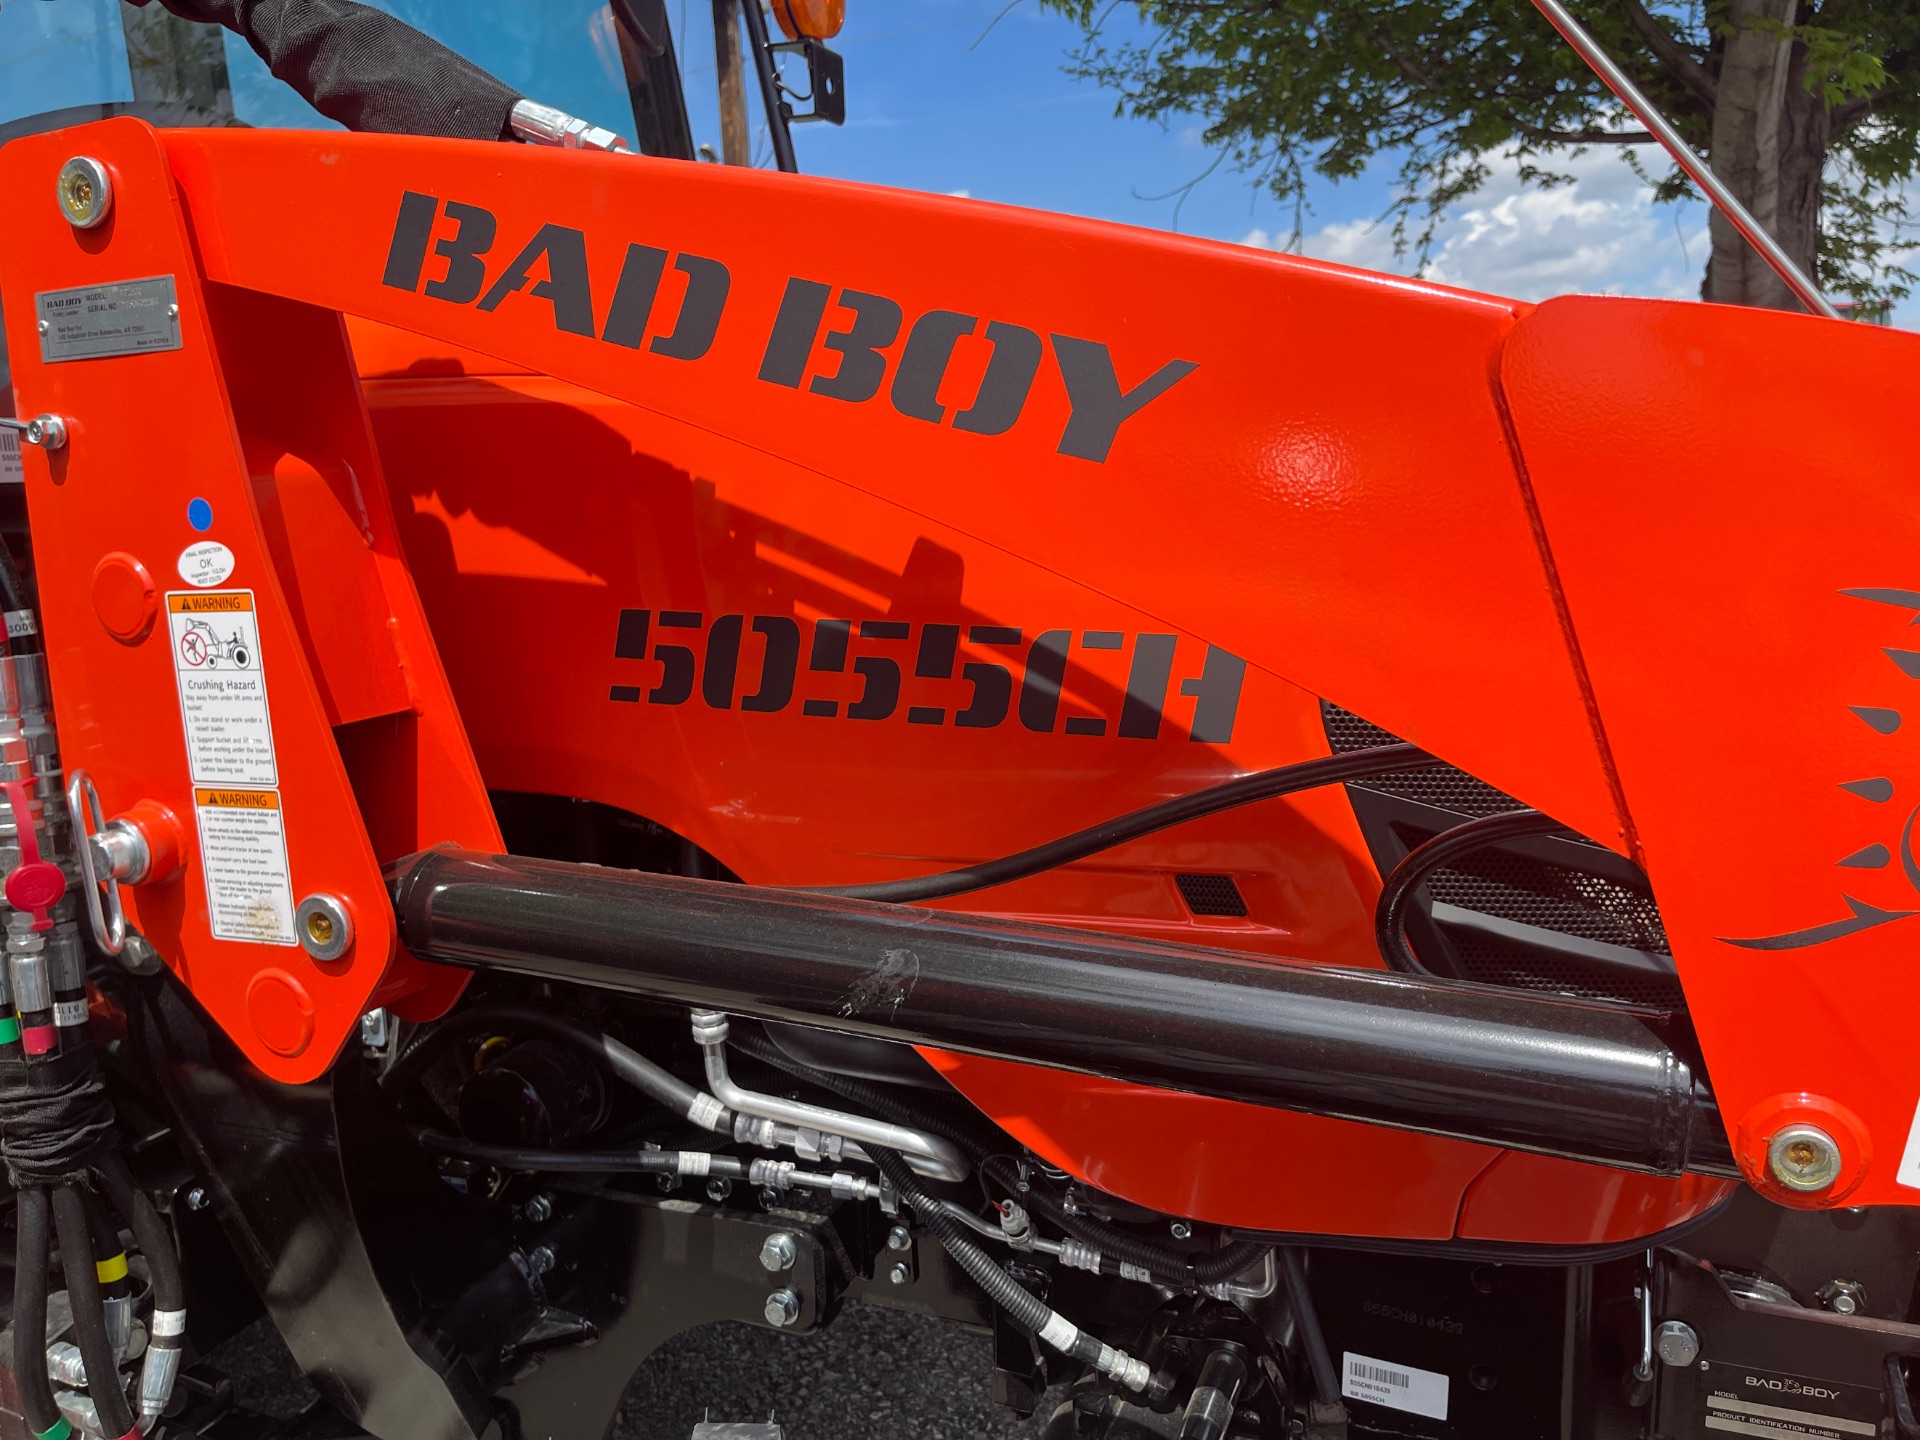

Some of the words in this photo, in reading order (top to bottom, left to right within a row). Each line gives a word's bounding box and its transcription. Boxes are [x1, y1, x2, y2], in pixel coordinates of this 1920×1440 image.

[47, 299, 64, 308] BAD
[66, 298, 82, 307] BOY
[88, 305, 107, 313] SERIAL
[382, 190, 731, 362] BAD
[757, 275, 1201, 464] BOY
[200, 558, 213, 568] OK
[192, 596, 241, 610] WARNING
[608, 607, 1247, 744] 5055CH
[188, 679, 224, 692] Crushing
[226, 679, 256, 690] Hazard
[219, 793, 267, 807] WARNING
[1714, 1390, 1739, 1400] MODEL
[1745, 1376, 1782, 1390] BAD
[1802, 1386, 1840, 1400] BOY
[1712, 1411, 1746, 1422] PRODUCT
[1749, 1417, 1805, 1432] IDENTIFICATION
[1809, 1428, 1840, 1439] NUMBER
